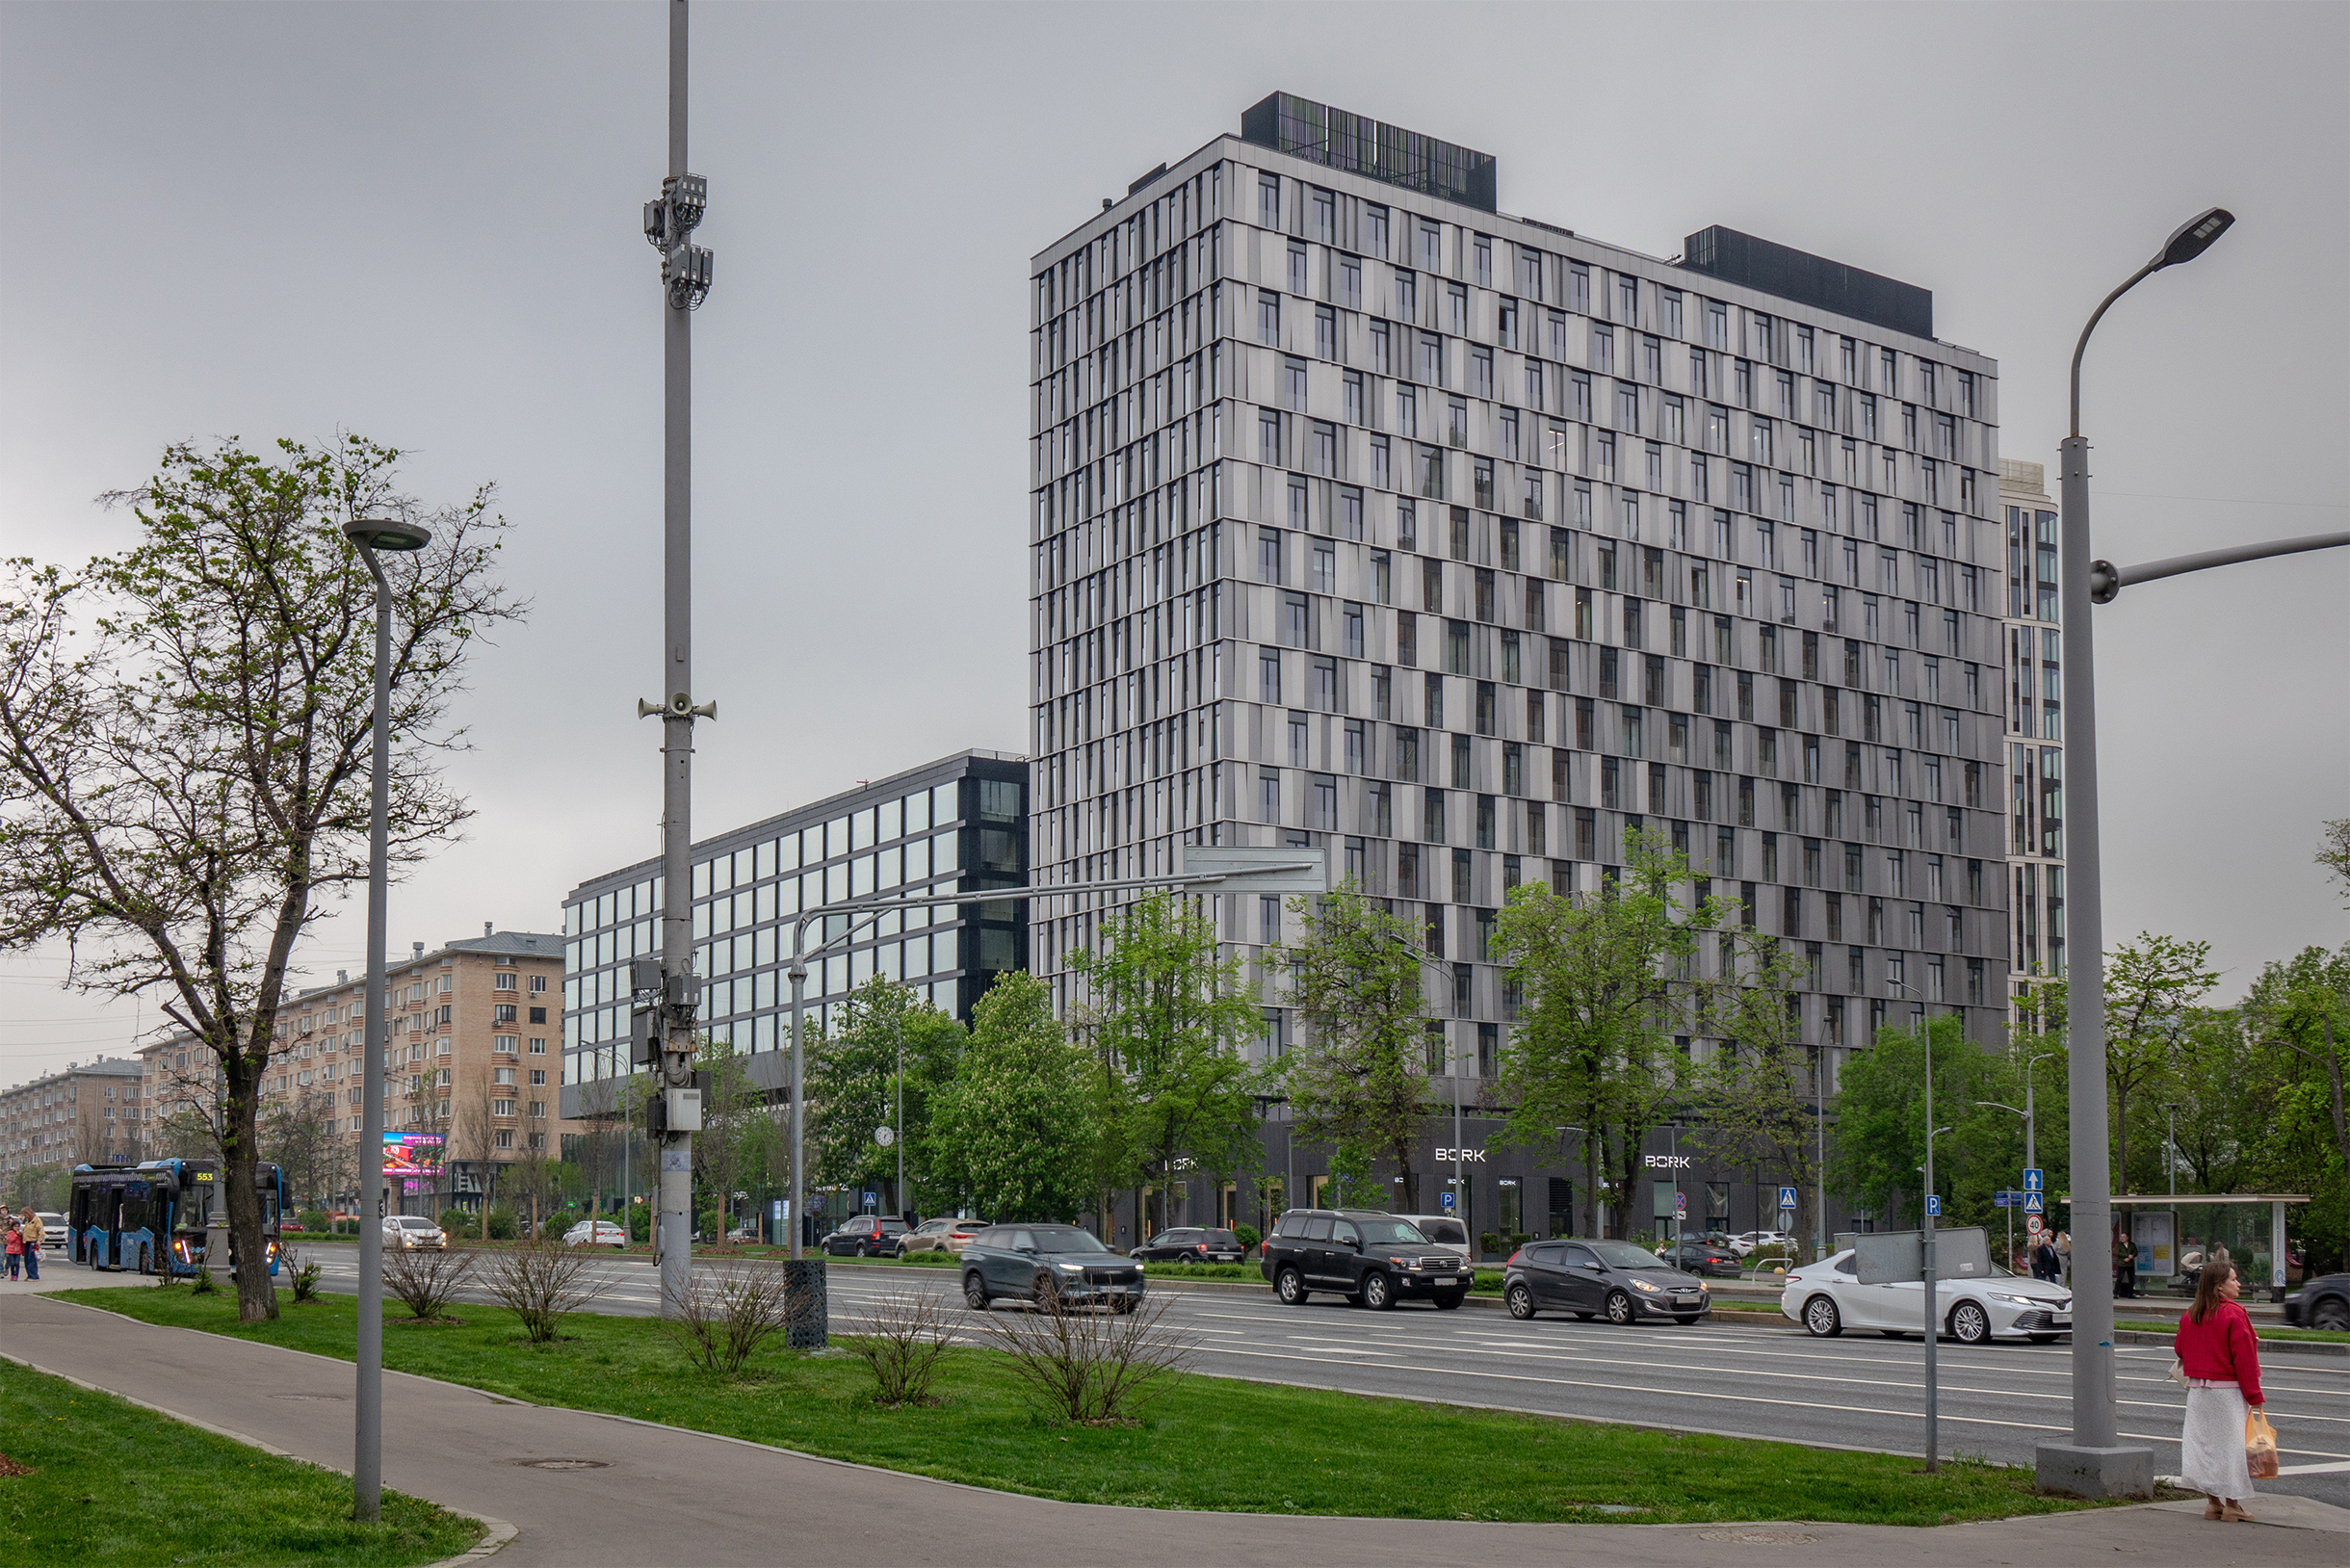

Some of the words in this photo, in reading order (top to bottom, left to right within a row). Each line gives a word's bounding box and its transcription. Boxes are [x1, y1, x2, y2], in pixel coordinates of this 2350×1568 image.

[1435, 1147, 1486, 1163] BORK
[1645, 1155, 1690, 1168] BORK
[1164, 1157, 1199, 1171] ORK
[196, 1172, 213, 1181] 553
[1445, 1194, 1452, 1206] P
[1929, 1197, 1938, 1214] P
[2029, 1220, 2040, 1229] 40
